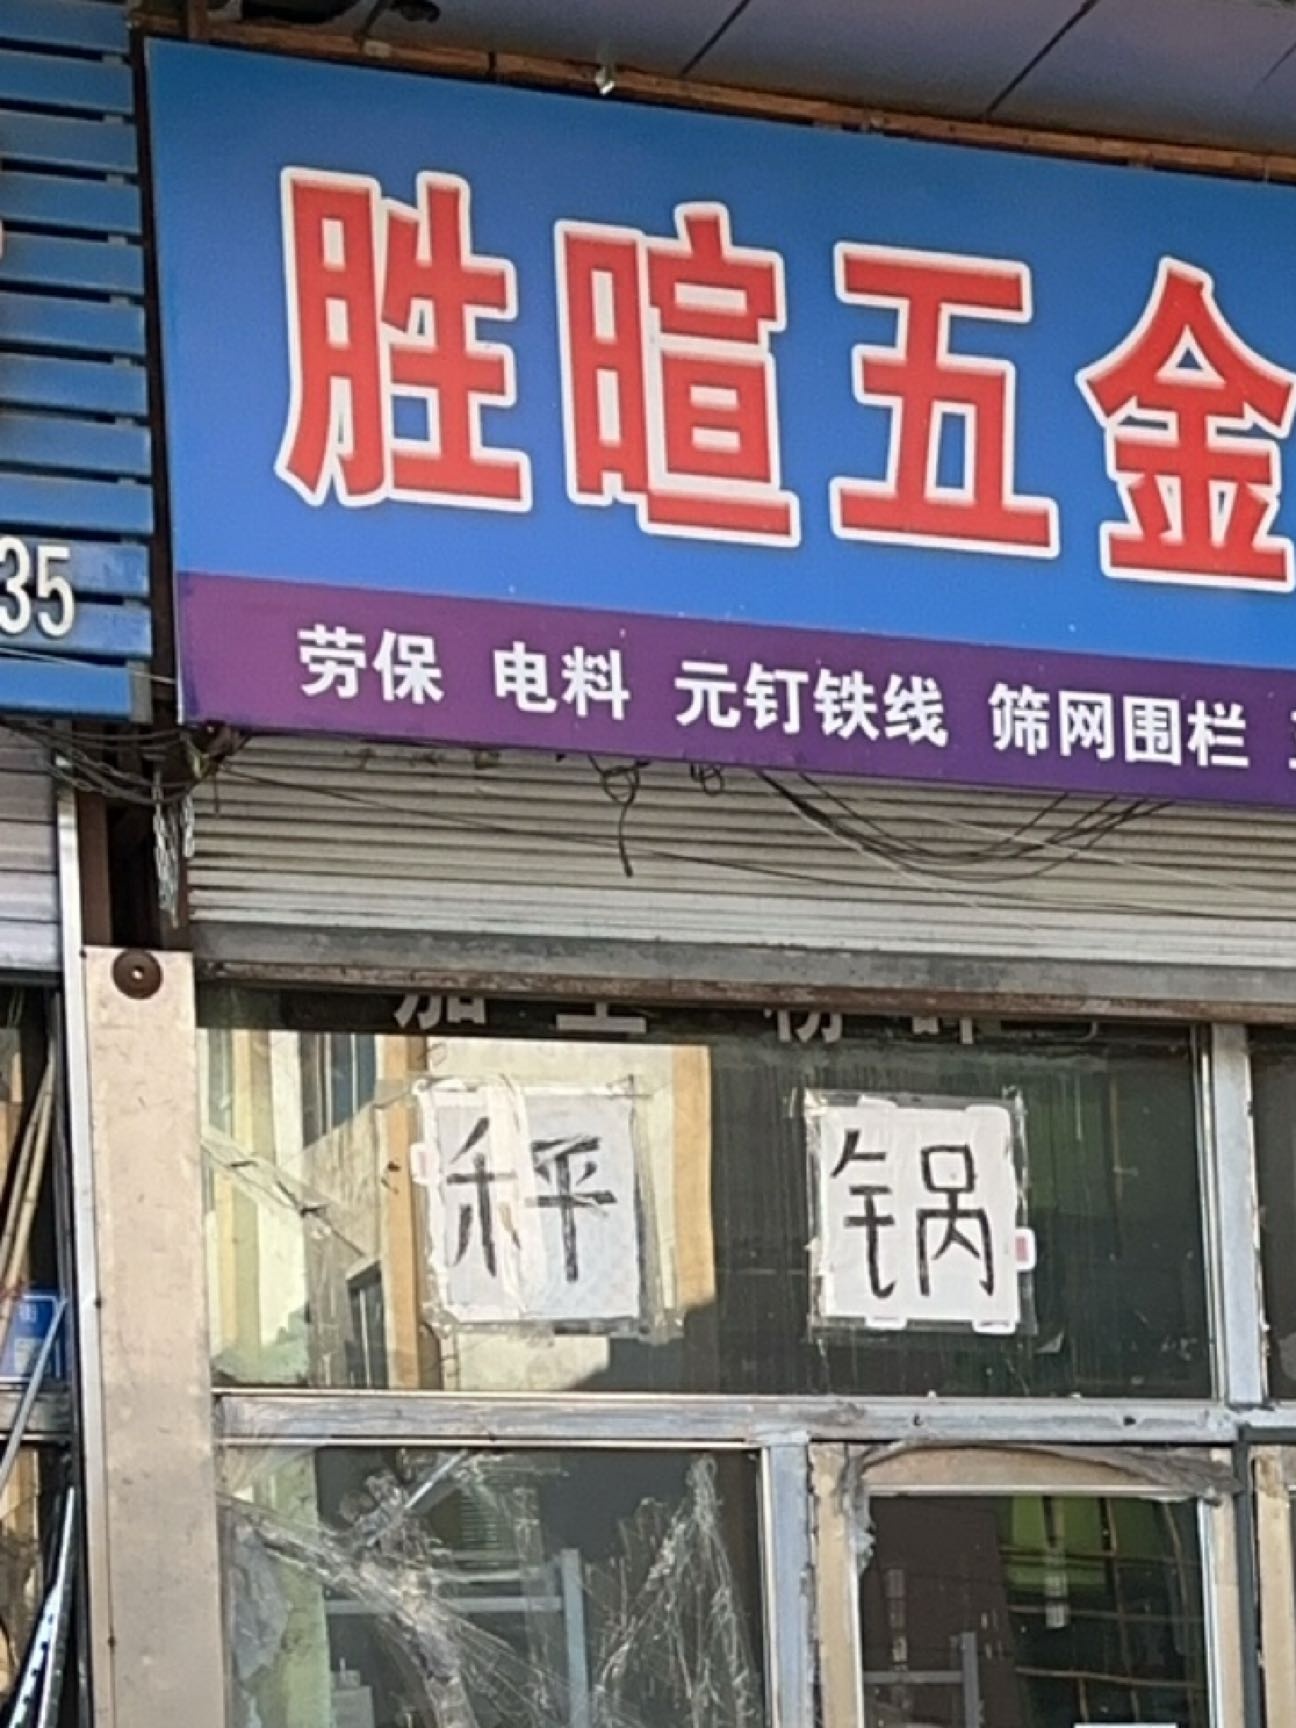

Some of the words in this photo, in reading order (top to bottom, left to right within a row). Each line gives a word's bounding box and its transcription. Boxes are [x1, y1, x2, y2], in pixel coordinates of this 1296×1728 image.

[0, 537, 74, 636] 35
[297, 624, 444, 705] 劳保
[493, 641, 630, 721] 电料
[674, 660, 949, 748] 元钉铁线
[987, 682, 1250, 768] 筛网围栏
[831, 1128, 995, 1298] 锅
